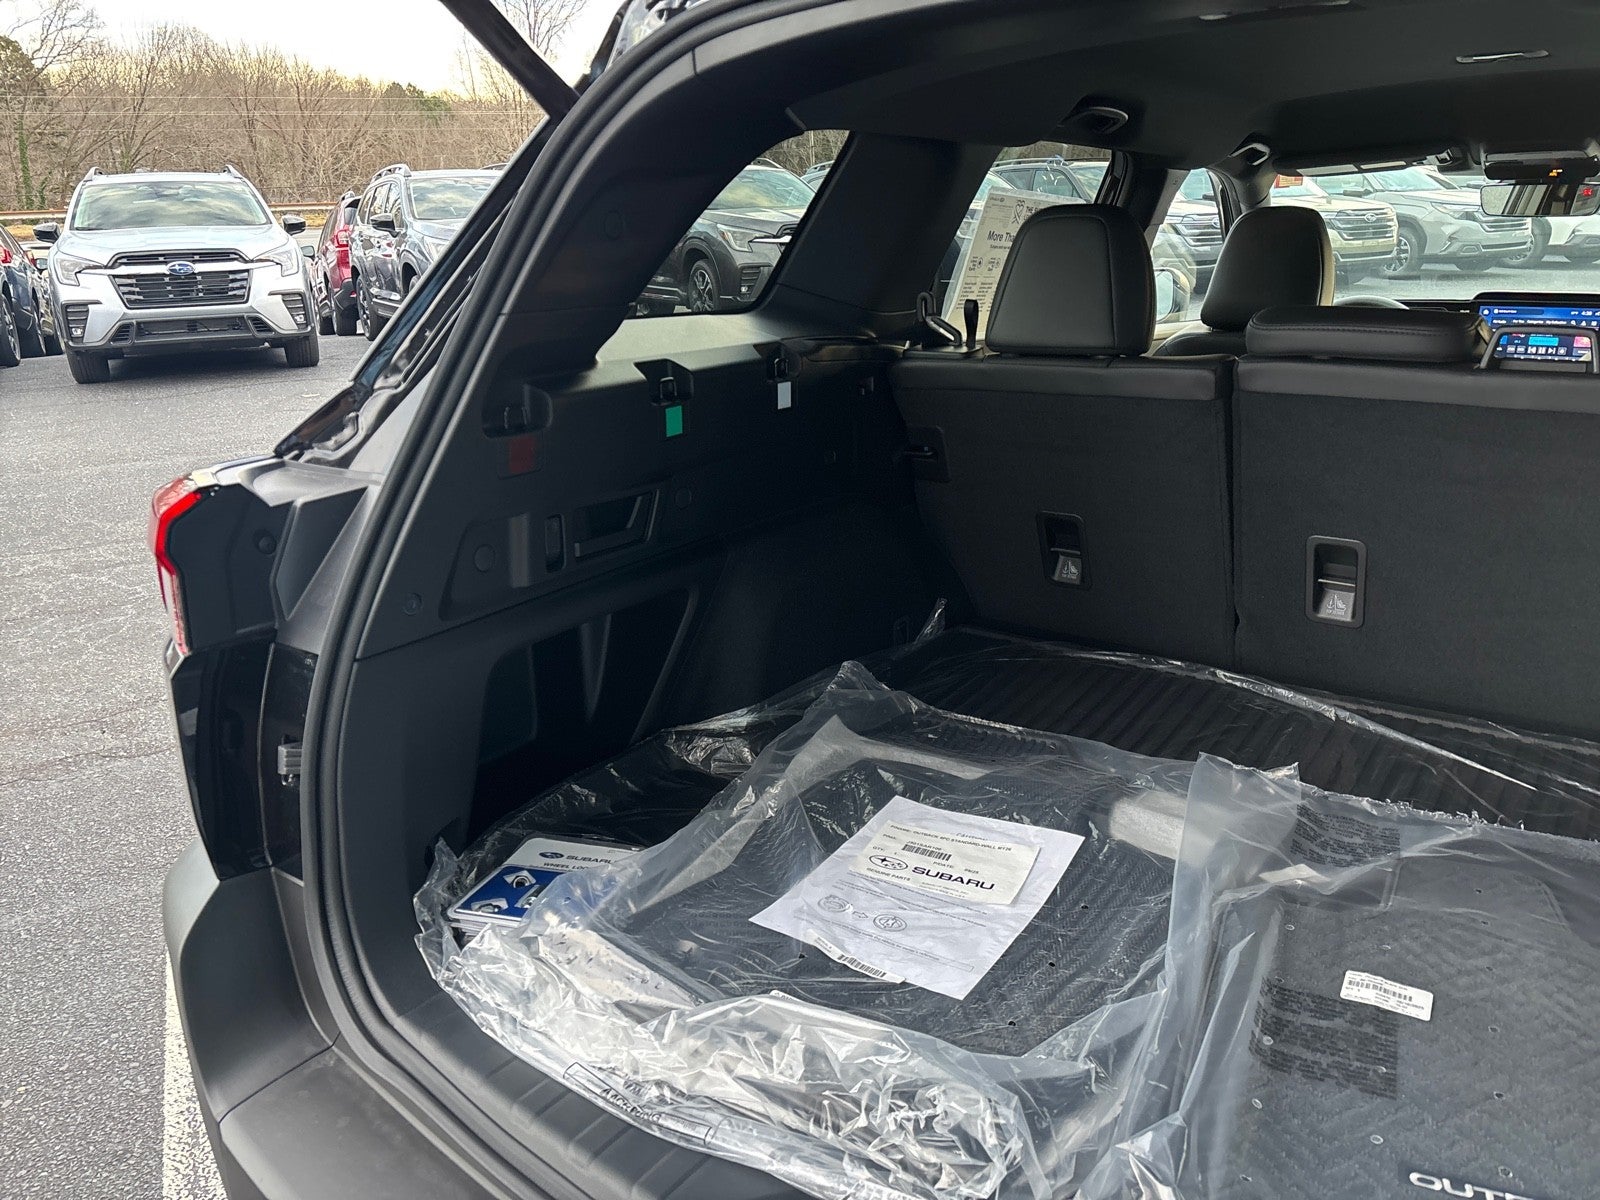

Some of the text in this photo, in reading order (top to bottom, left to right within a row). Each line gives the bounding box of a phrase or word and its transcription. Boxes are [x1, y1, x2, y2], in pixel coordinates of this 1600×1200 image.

[987, 230, 1004, 242] More
[891, 874, 911, 882] PARTS
[911, 866, 995, 890] SUBARU
